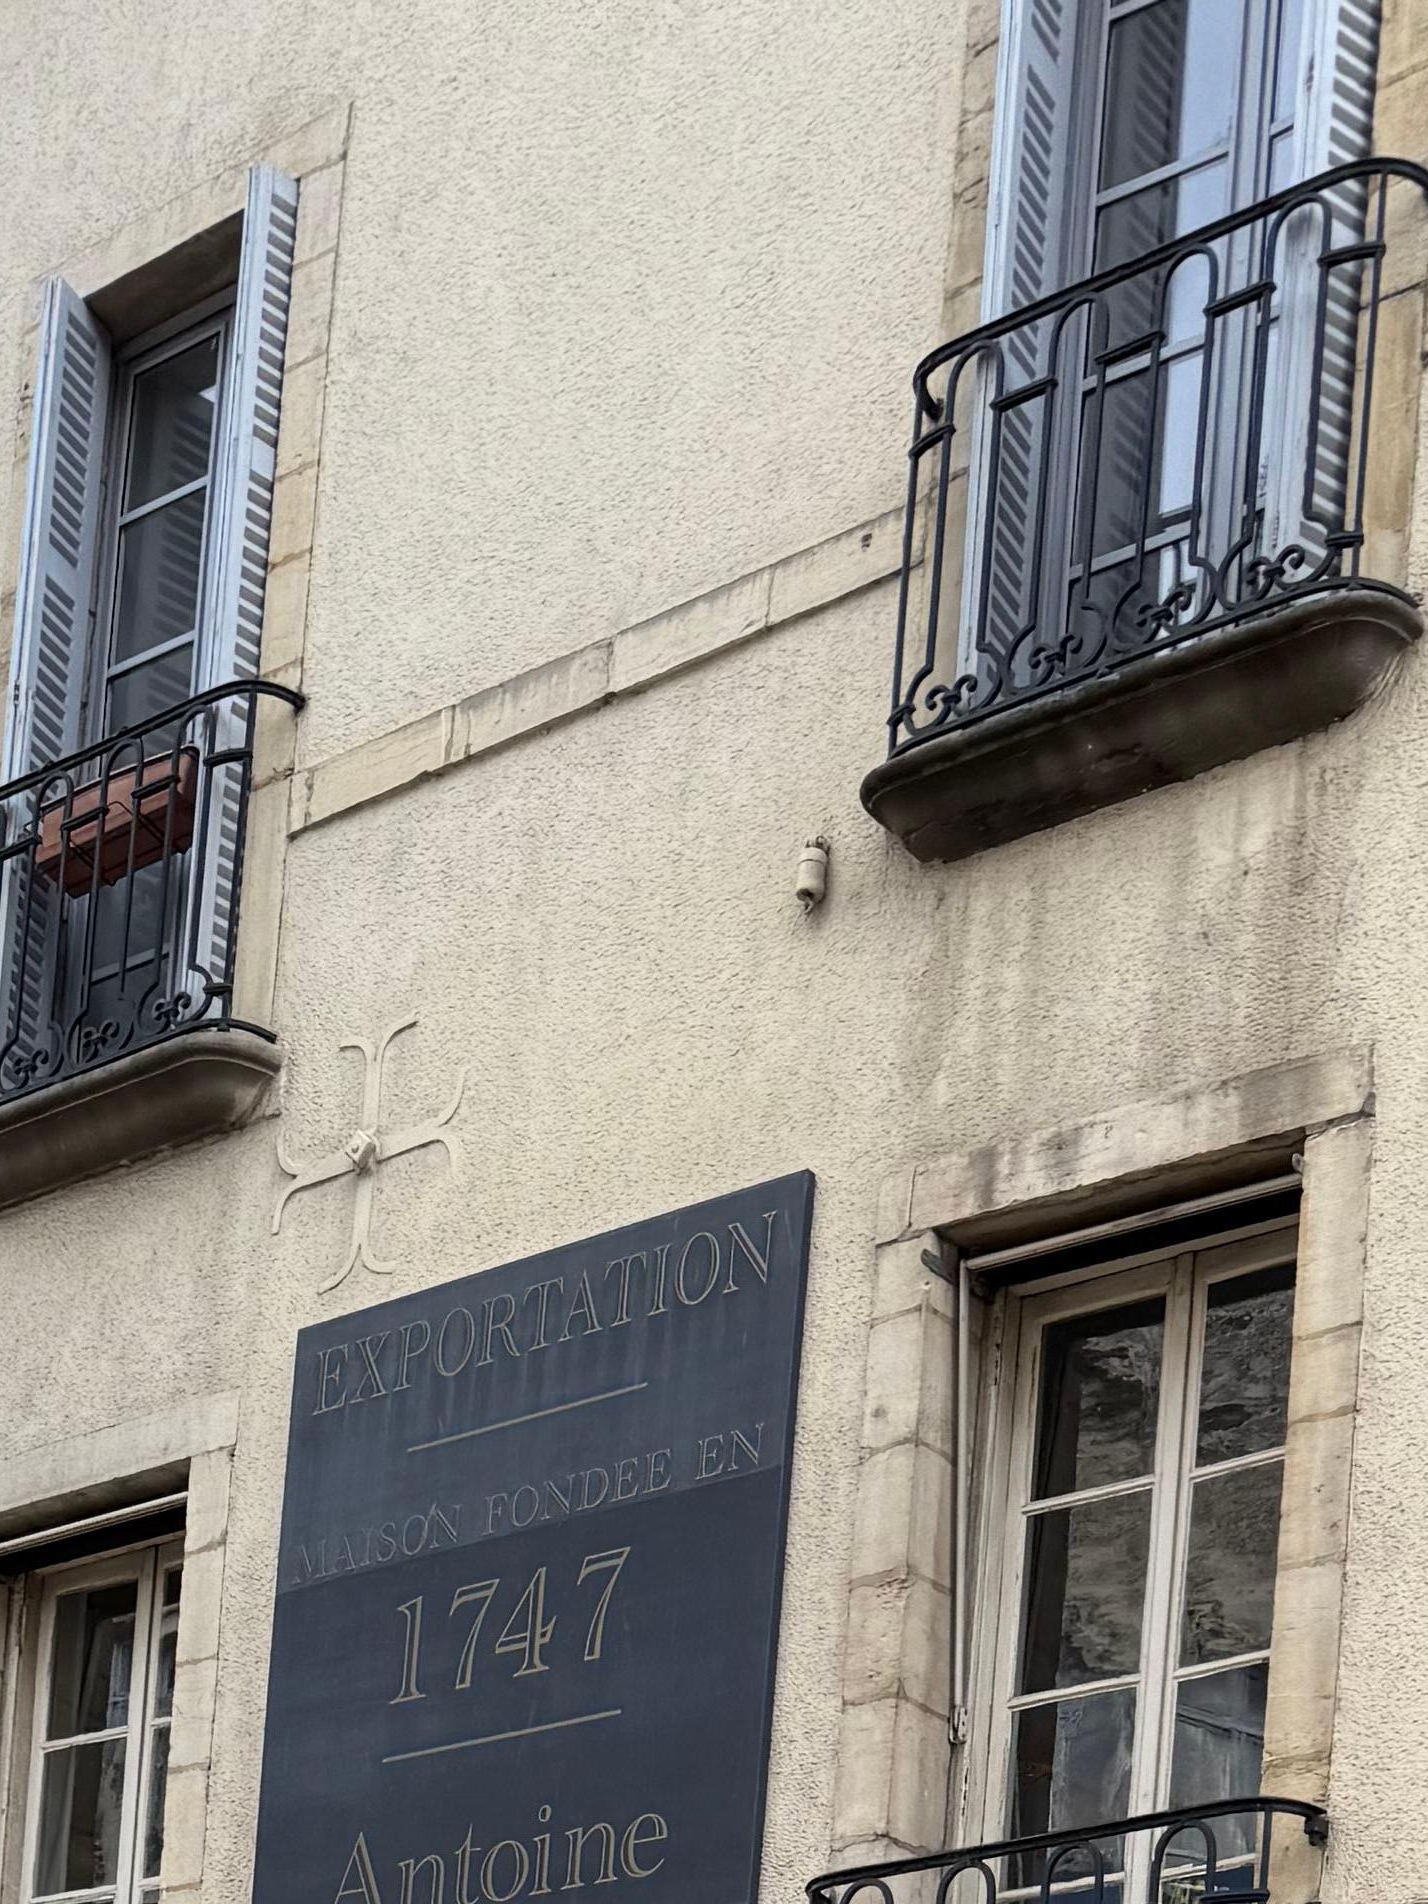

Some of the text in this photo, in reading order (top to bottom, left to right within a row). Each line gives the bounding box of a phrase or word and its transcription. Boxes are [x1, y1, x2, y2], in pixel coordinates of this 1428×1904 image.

[312, 1210, 777, 1415] EXPORTATION
[291, 1503, 461, 1584] MAISON
[695, 1423, 764, 1481] EN
[389, 1546, 631, 1704] 1747
